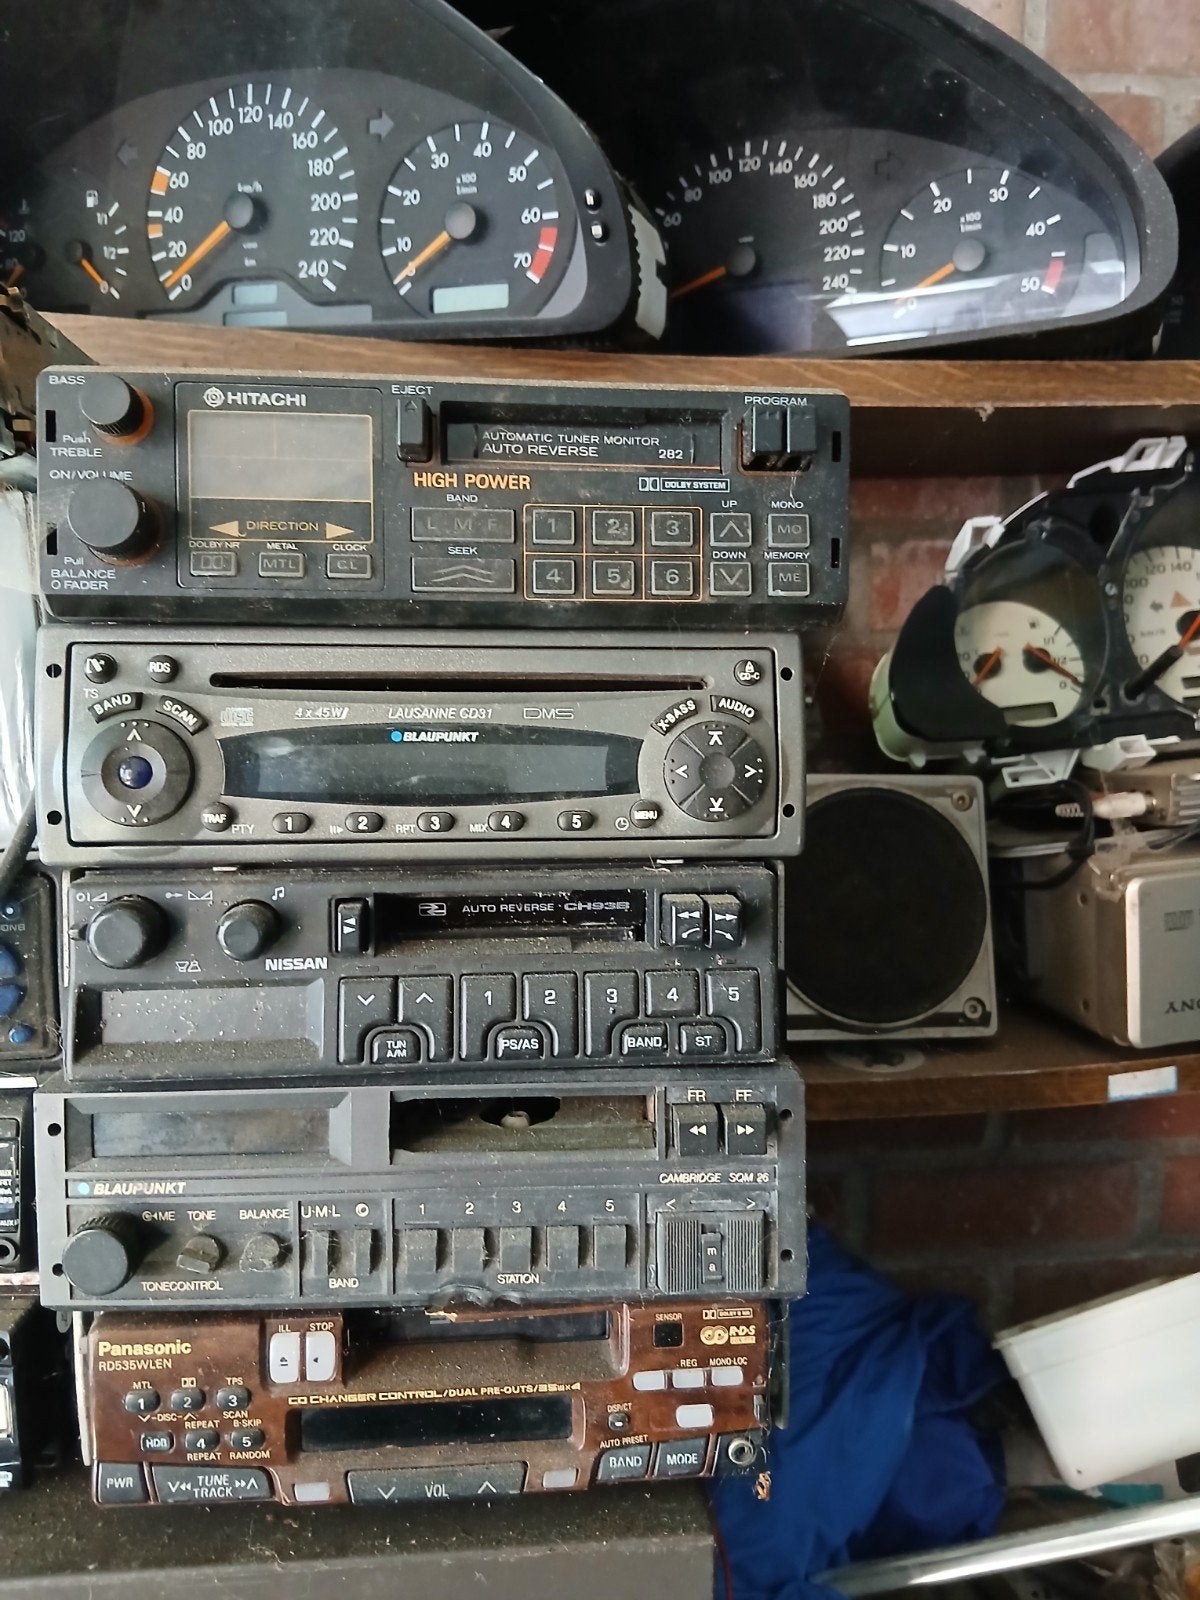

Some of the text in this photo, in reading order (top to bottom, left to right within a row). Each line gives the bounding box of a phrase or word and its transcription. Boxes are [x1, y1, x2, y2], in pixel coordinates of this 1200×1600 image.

[238, 106, 263, 124] 120
[268, 111, 294, 130] 140
[208, 118, 234, 135] 100
[292, 131, 318, 149] 160
[186, 142, 206, 159] 80
[473, 142, 492, 158] 40
[307, 158, 334, 176] 180
[431, 153, 449, 169] 30
[738, 156, 761, 172] 120
[769, 159, 793, 176] 140
[169, 171, 189, 188] 60
[507, 166, 527, 183] 50
[708, 168, 732, 184] 100
[793, 172, 818, 189] 160
[402, 189, 420, 206] 20
[684, 187, 702, 202] 80
[812, 192, 837, 209] 180
[989, 187, 1008, 202] 30
[310, 193, 341, 212] 200
[933, 198, 951, 214] 20
[164, 206, 183, 223] 40
[521, 207, 540, 223] 60
[664, 212, 682, 228] 60
[819, 217, 848, 235] 200
[1025, 221, 1045, 237] 40
[309, 227, 340, 246] 220
[168, 241, 187, 258] 20
[397, 237, 412, 252] 10
[824, 245, 851, 262] 220
[901, 244, 916, 258] 10
[513, 253, 532, 269] 70
[298, 260, 329, 278] 240
[180, 274, 192, 291] 0
[822, 274, 849, 291] 240
[1020, 276, 1040, 293] 50
[49, 375, 86, 385] BASS
[391, 385, 434, 395] EJECT
[227, 391, 307, 407] HITACHI
[744, 396, 808, 406] PROGRAM
[62, 431, 92, 444] Push
[482, 431, 660, 446] AUTOMATIC TUNER MONITOR
[50, 447, 103, 457] TREBLE
[482, 443, 599, 457] AUTO REVERSE
[658, 449, 683, 459] 282
[413, 472, 531, 490] HIGH POWER
[664, 480, 726, 489] DOLBY SYSTEM
[446, 494, 478, 503] BAND
[721, 500, 738, 508] UP
[771, 500, 804, 509] MONO
[246, 521, 319, 532] DIRECTION
[547, 518, 556, 533] 1
[607, 518, 621, 535] 2
[666, 520, 680, 536] 3
[777, 524, 802, 534] MO
[189, 541, 240, 549] DOLBY NR
[266, 542, 299, 550] METAL
[332, 543, 367, 551] CLOCK
[447, 547, 478, 555] SEEK
[64, 556, 84, 566] Pull
[712, 551, 747, 559] DOWN
[764, 551, 810, 560] MEMORY
[263, 559, 297, 569] MTL
[336, 560, 358, 570] CL
[1145, 564, 1166, 575] 120
[1171, 561, 1192, 572] 140
[50, 569, 116, 579] BALANCE
[546, 568, 561, 583] 4
[607, 569, 621, 584] 5
[666, 569, 680, 584] 6
[778, 572, 801, 582] ME
[64, 580, 109, 590] FADER
[150, 661, 171, 673] RDS
[83, 688, 99, 698] TS
[93, 693, 132, 715] BAND
[719, 698, 755, 718] AUDIO
[162, 700, 198, 726] SCAN
[294, 708, 303, 718] 4
[388, 708, 493, 719] LAUSANNE CD31
[523, 708, 574, 719] DMS
[658, 700, 696, 731] X-BASS
[403, 731, 479, 742] BLAUPUNKT
[203, 814, 227, 823] TRAF
[634, 810, 658, 820] MENU
[284, 817, 293, 831] 1
[358, 816, 368, 830] 2
[430, 816, 440, 830] 3
[500, 815, 511, 828] 4
[572, 815, 582, 829] 5
[231, 824, 255, 834] PTY
[395, 824, 416, 834] RPT
[469, 824, 488, 833] MIX
[462, 904, 497, 913] AUTO
[500, 903, 555, 912] REVERSE
[265, 957, 328, 971] NISSAN
[484, 990, 492, 1005] 1
[544, 990, 556, 1005] 2
[606, 988, 618, 1003] 3
[666, 987, 679, 1002] 4
[728, 987, 740, 1001] 5
[386, 1040, 407, 1048] TUN
[502, 1038, 539, 1049] PS/AS
[627, 1036, 663, 1047] BAND
[695, 1036, 712, 1046] ST
[386, 1049, 407, 1058] A/M
[688, 1090, 706, 1102] FR
[735, 1090, 752, 1101] FF
[659, 1173, 769, 1183] CAMBRIDGE SQM 26
[94, 1182, 186, 1195] BLAUPUNKT
[465, 1202, 474, 1215] 2
[512, 1201, 522, 1214] 3
[557, 1200, 567, 1212] 4
[605, 1200, 615, 1212] 5
[186, 1210, 216, 1220] TONE
[239, 1208, 290, 1220] BALANCE
[328, 1277, 359, 1288] BAND
[497, 1273, 540, 1284] STATION
[141, 1280, 224, 1291] TONECONTROL
[655, 1313, 683, 1321] SENSOR
[278, 1324, 291, 1332] ILL
[309, 1322, 334, 1332] STOP
[98, 1339, 192, 1357] Panasonic
[99, 1359, 172, 1371] RD535WLEN
[680, 1359, 698, 1367] REG
[133, 1381, 152, 1389] MTL
[226, 1377, 243, 1386] TPS
[137, 1398, 145, 1410] 1
[184, 1397, 192, 1408] 2
[228, 1395, 238, 1406] 3
[288, 1396, 308, 1405] CD
[309, 1393, 377, 1404] CHANGER
[223, 1410, 248, 1419] SCAN
[185, 1420, 220, 1429] REPEAT
[196, 1438, 205, 1449] 4
[242, 1437, 252, 1448] 5
[600, 1434, 648, 1449] AUTO PRESET
[187, 1453, 221, 1461] REPEAT
[230, 1451, 271, 1460] RANDOM
[666, 1453, 698, 1465] MODE
[609, 1456, 642, 1468] BAND
[106, 1477, 133, 1489] PWR
[197, 1475, 229, 1487] TUNE
[193, 1487, 233, 1498] TRACK
[424, 1484, 449, 1499] VOL
